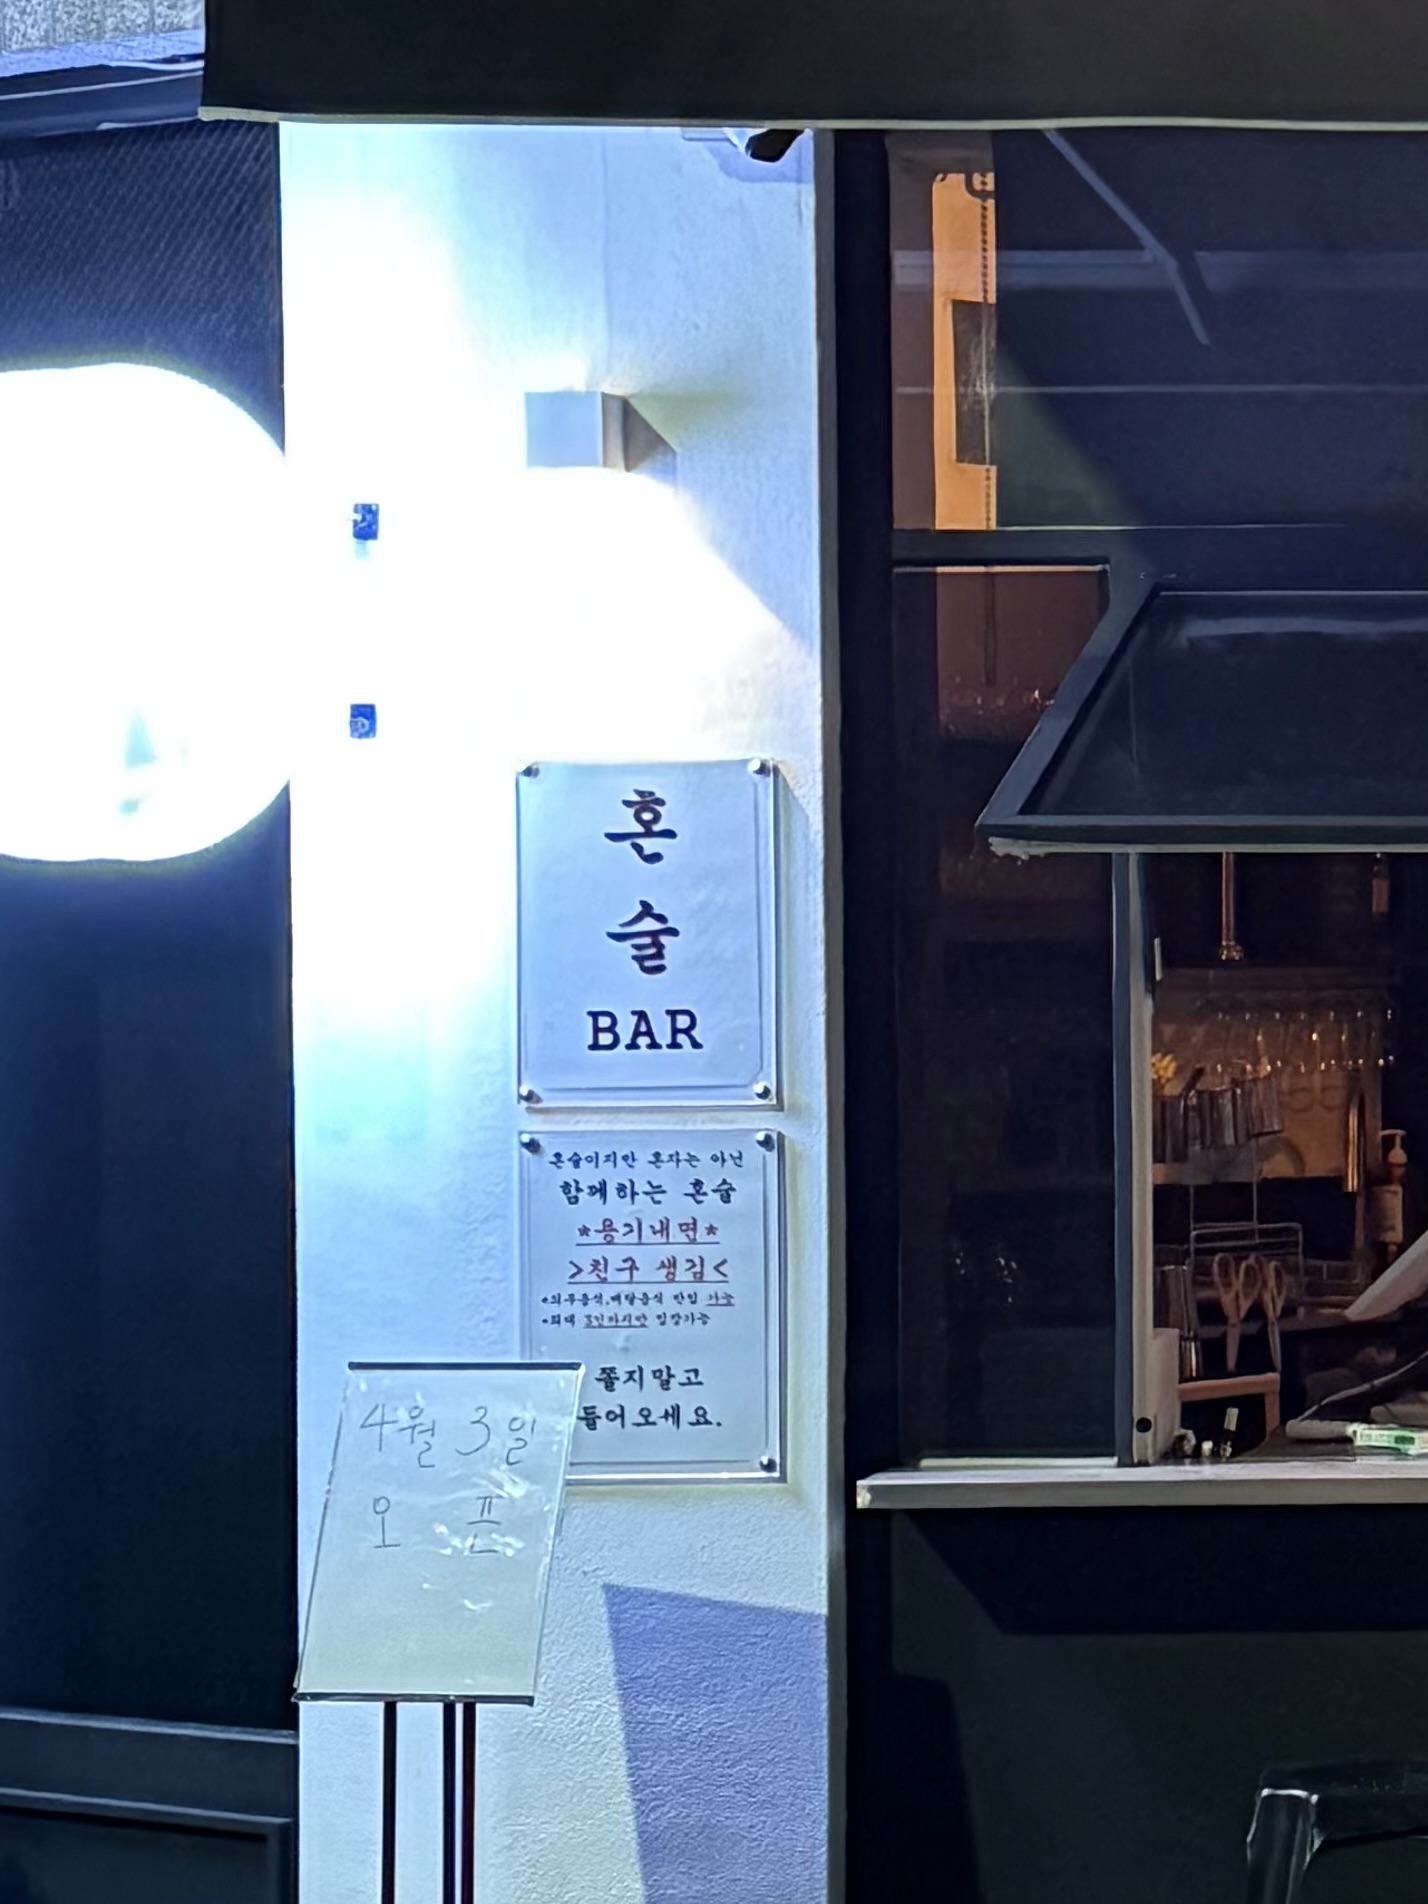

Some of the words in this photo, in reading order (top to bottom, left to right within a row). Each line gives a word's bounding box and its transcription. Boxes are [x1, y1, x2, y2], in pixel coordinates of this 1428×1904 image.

[586, 1009, 704, 1051] BAR
[549, 1150, 638, 1169] 혼술이지만
[647, 1150, 701, 1168] 혼자는
[710, 1150, 744, 1168] 아닌
[559, 1178, 667, 1205] 함께하는
[683, 1178, 737, 1205] 혼술
[594, 1364, 704, 1392] 쫄지말고
[577, 1403, 722, 1431] 들어오세요.
[360, 1403, 436, 1468] 4월
[455, 1406, 537, 1466] 3일
